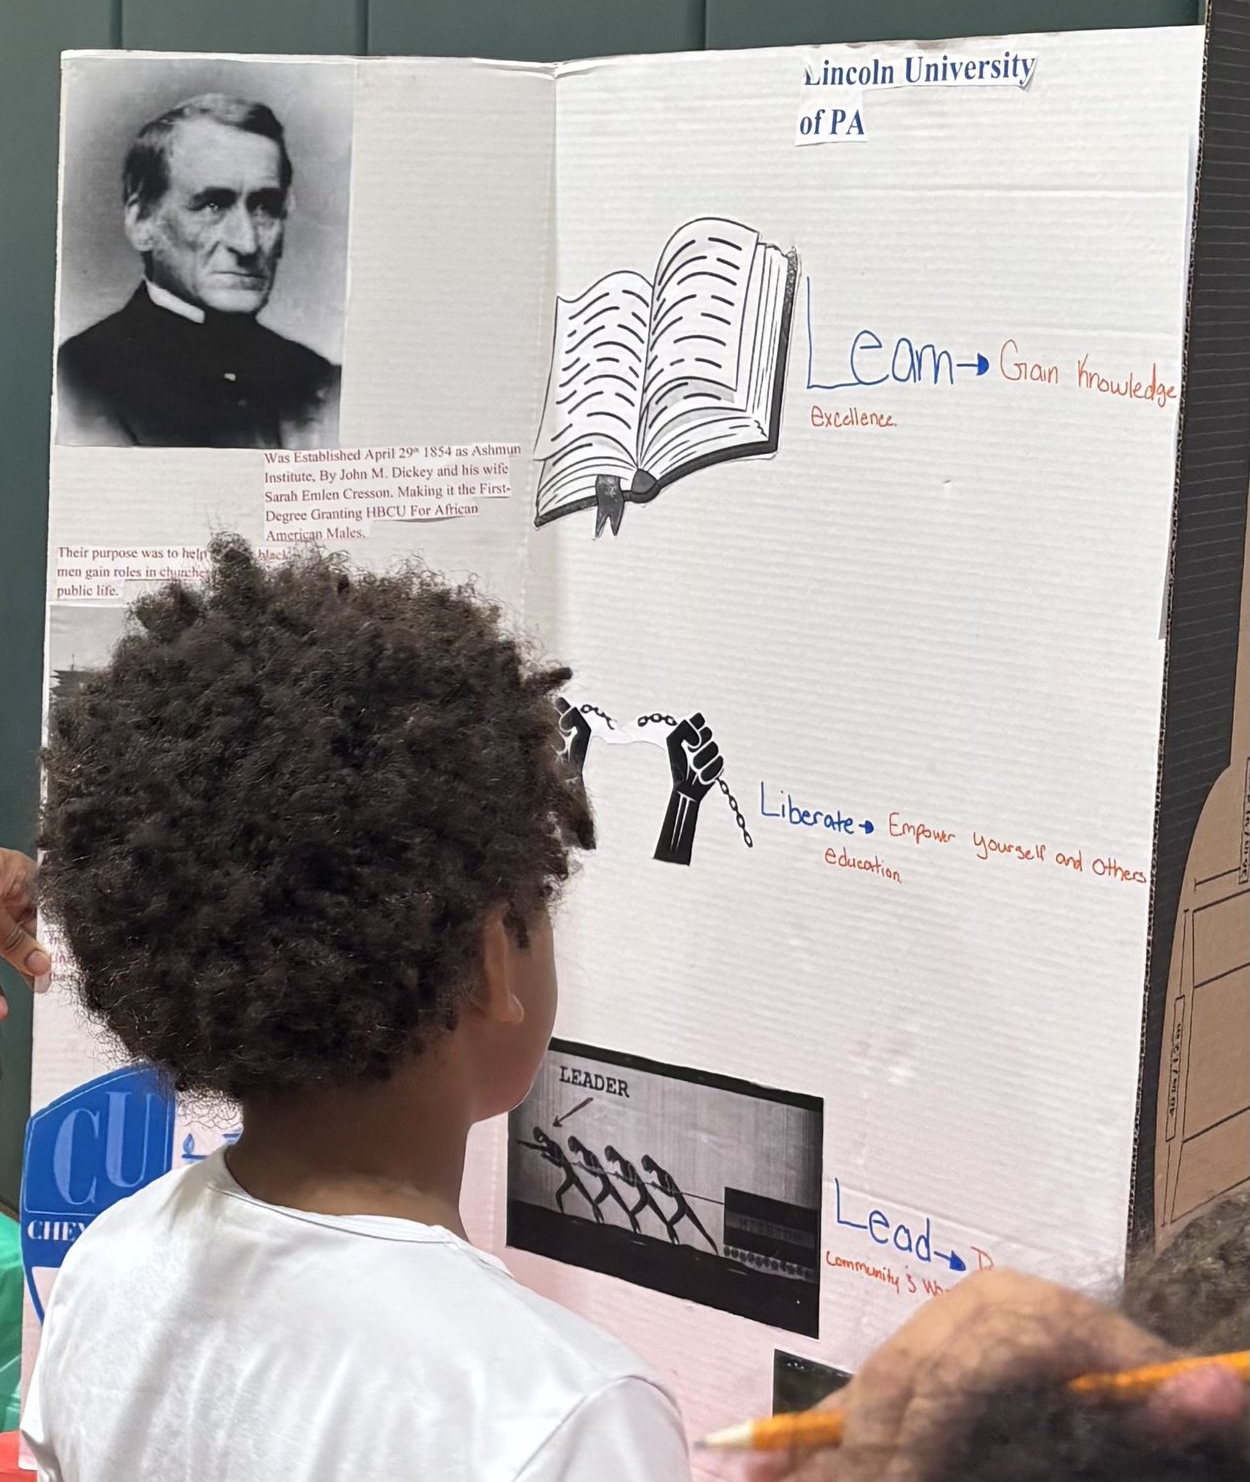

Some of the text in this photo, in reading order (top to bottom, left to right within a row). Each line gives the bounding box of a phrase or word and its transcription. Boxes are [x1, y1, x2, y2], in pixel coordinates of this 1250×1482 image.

[805, 51, 1036, 86] Lincoln University
[800, 109, 864, 135] of PA
[806, 277, 1178, 408] Learn Gain Knowledge
[264, 452, 290, 464] Was
[294, 449, 361, 463] Established
[364, 448, 395, 463] April
[424, 446, 451, 458] 1854
[455, 447, 468, 456] as
[471, 444, 522, 456] Ashmun
[319, 470, 337, 484] By
[339, 468, 368, 481] John
[372, 468, 388, 479] M.
[392, 466, 433, 481] Dickey
[437, 465, 458, 477] and
[461, 464, 479, 475] his
[482, 463, 509, 475] wife
[264, 482, 511, 503] Sarah Emlen Cresson. Making it the First-
[265, 503, 479, 524] Degree Granting HBCU For African
[266, 528, 366, 542] American Males.
[58, 547, 89, 559] Their
[92, 549, 138, 561] purpose
[141, 549, 164, 558] was
[167, 549, 178, 559] to
[57, 568, 82, 577] men
[85, 568, 111, 579] gain
[114, 567, 142, 578] roles
[145, 566, 157, 577] in
[57, 584, 119, 598] public life.
[761, 781, 854, 834] Liberate
[888, 812, 956, 844] Empower
[1055, 850, 1083, 871] and
[1092, 859, 1147, 884] Others
[558, 1065, 630, 1098] LEADER
[53, 1091, 153, 1205] CU
[835, 1177, 931, 1262] Lead
